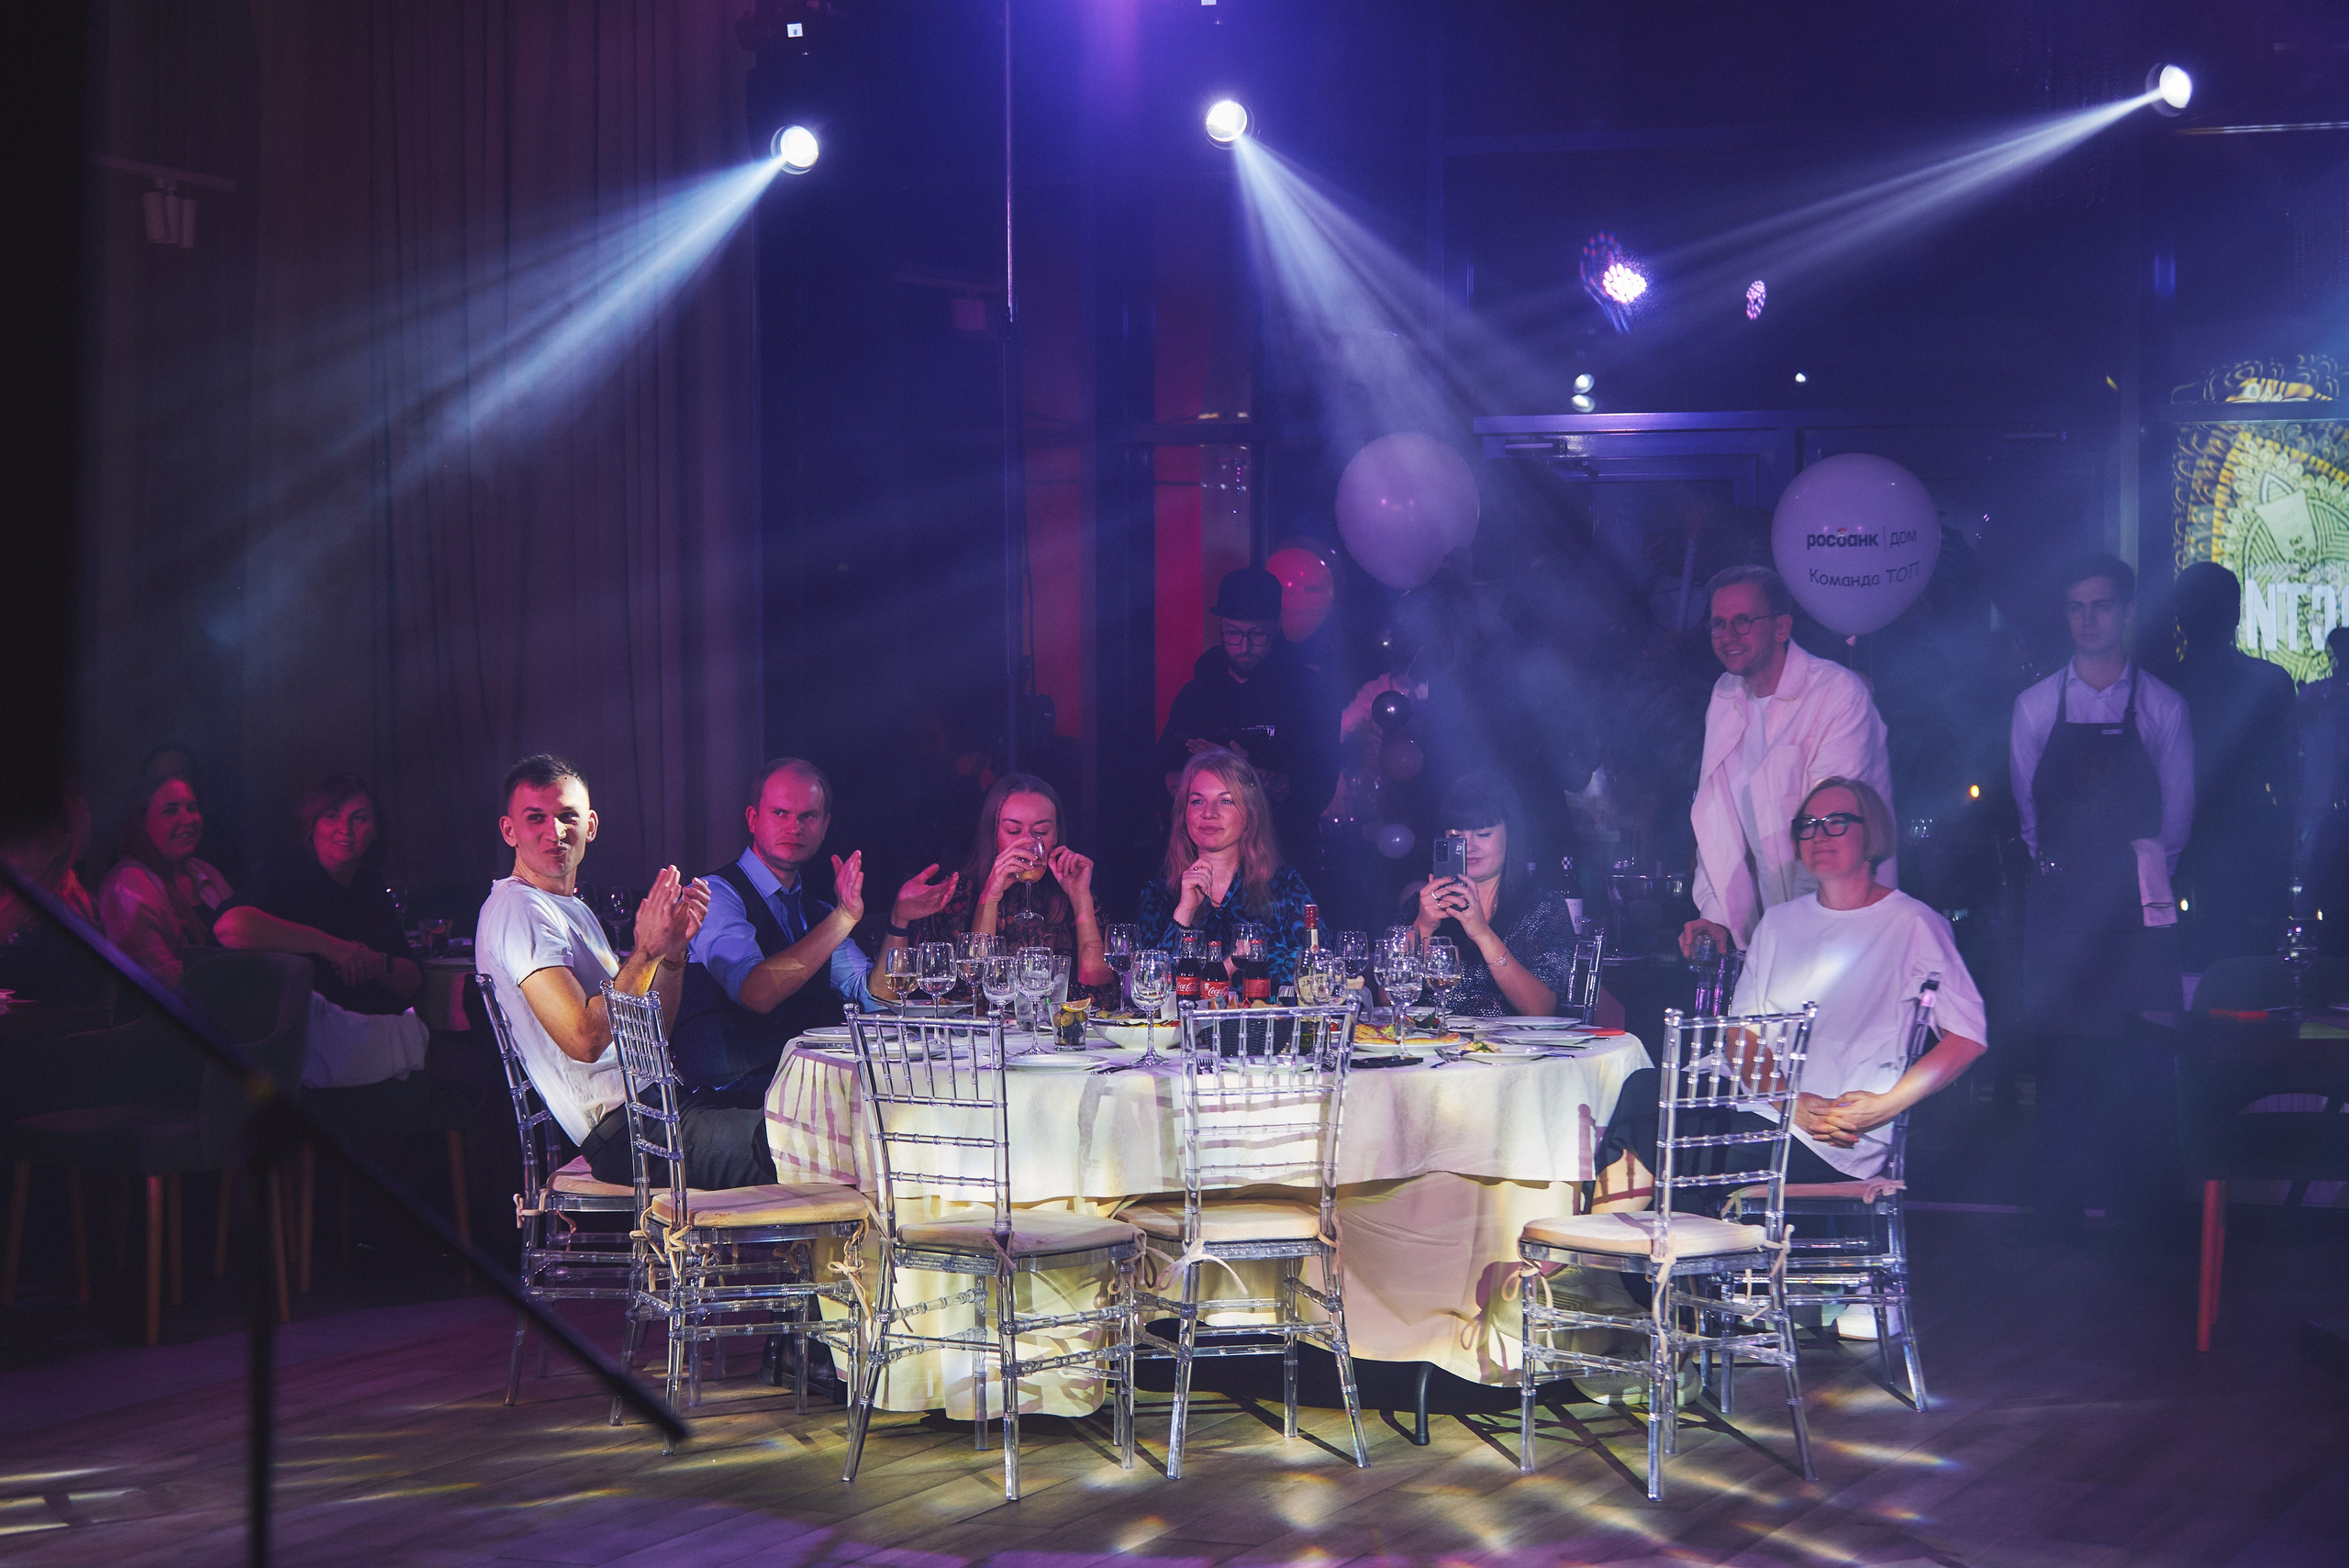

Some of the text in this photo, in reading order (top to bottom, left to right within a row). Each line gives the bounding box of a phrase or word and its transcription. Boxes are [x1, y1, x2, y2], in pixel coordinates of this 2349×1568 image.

[1807, 528, 1879, 550] росбанк
[1809, 561, 1920, 587] Команда ТОП
